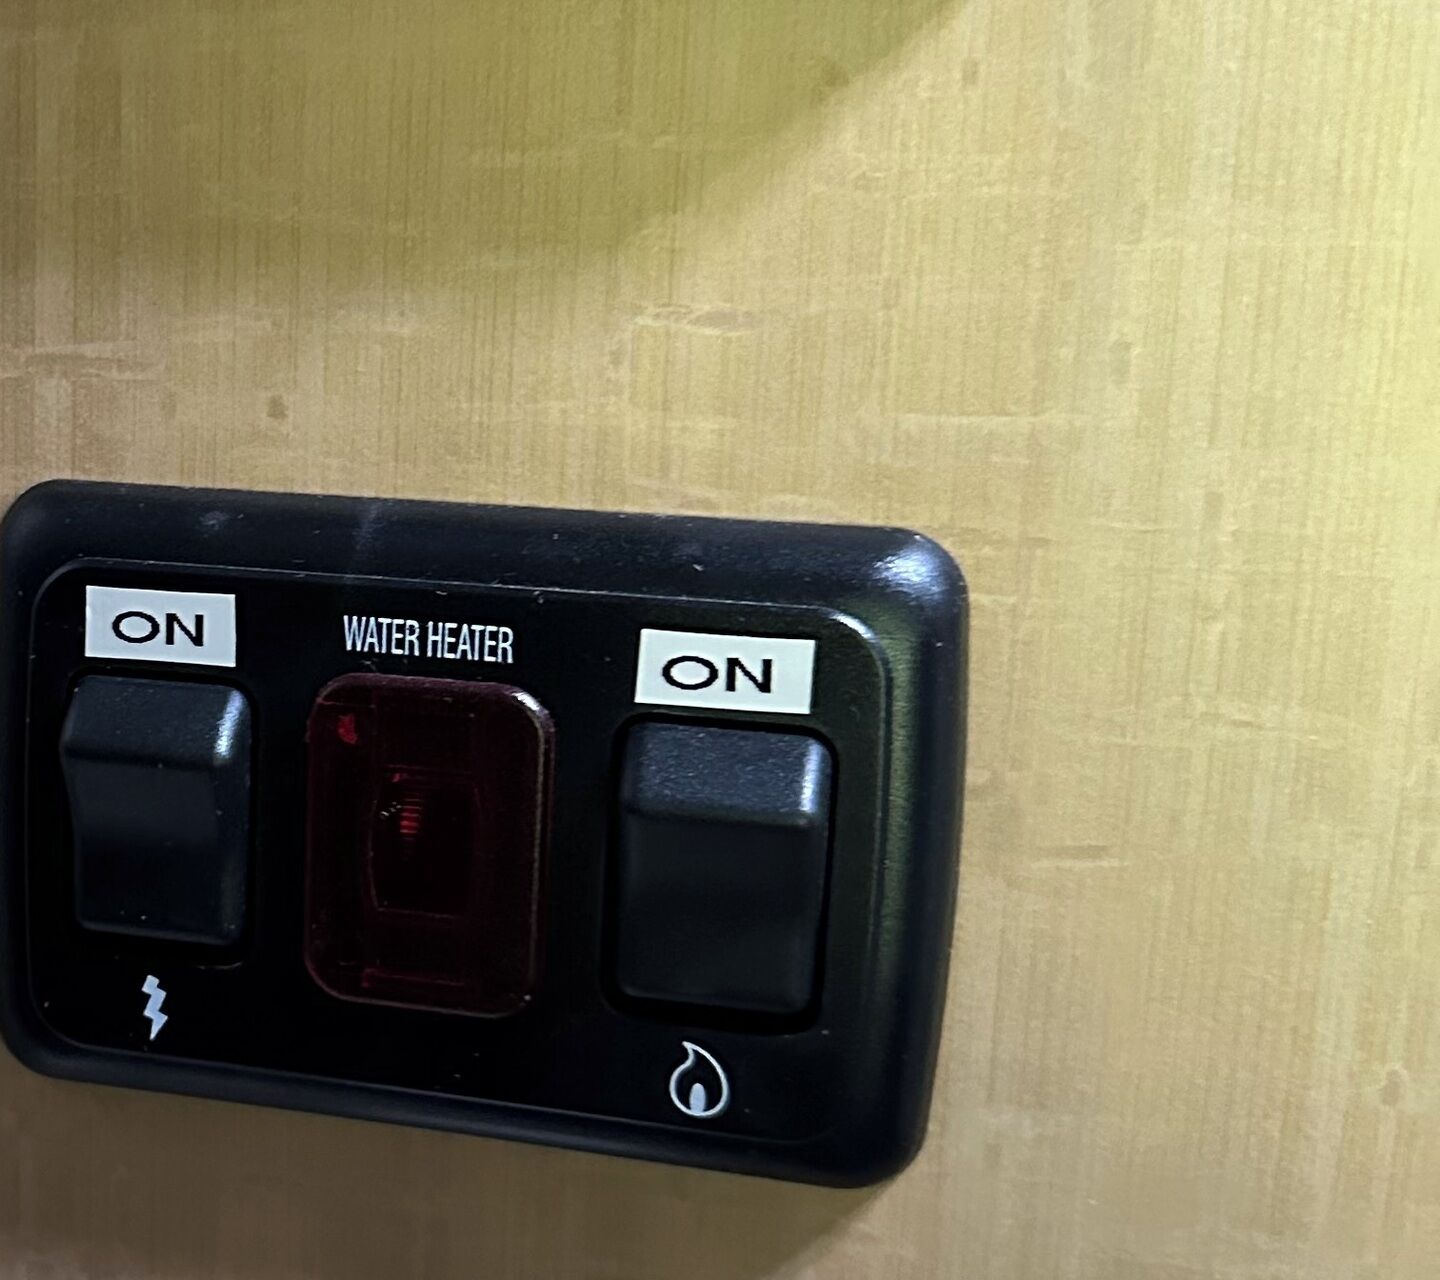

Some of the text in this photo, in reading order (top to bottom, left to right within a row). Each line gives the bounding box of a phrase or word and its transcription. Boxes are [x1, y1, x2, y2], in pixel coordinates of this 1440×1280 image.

[111, 610, 204, 648] ON
[343, 614, 514, 664] WATER HEATER
[661, 655, 773, 695] ON
